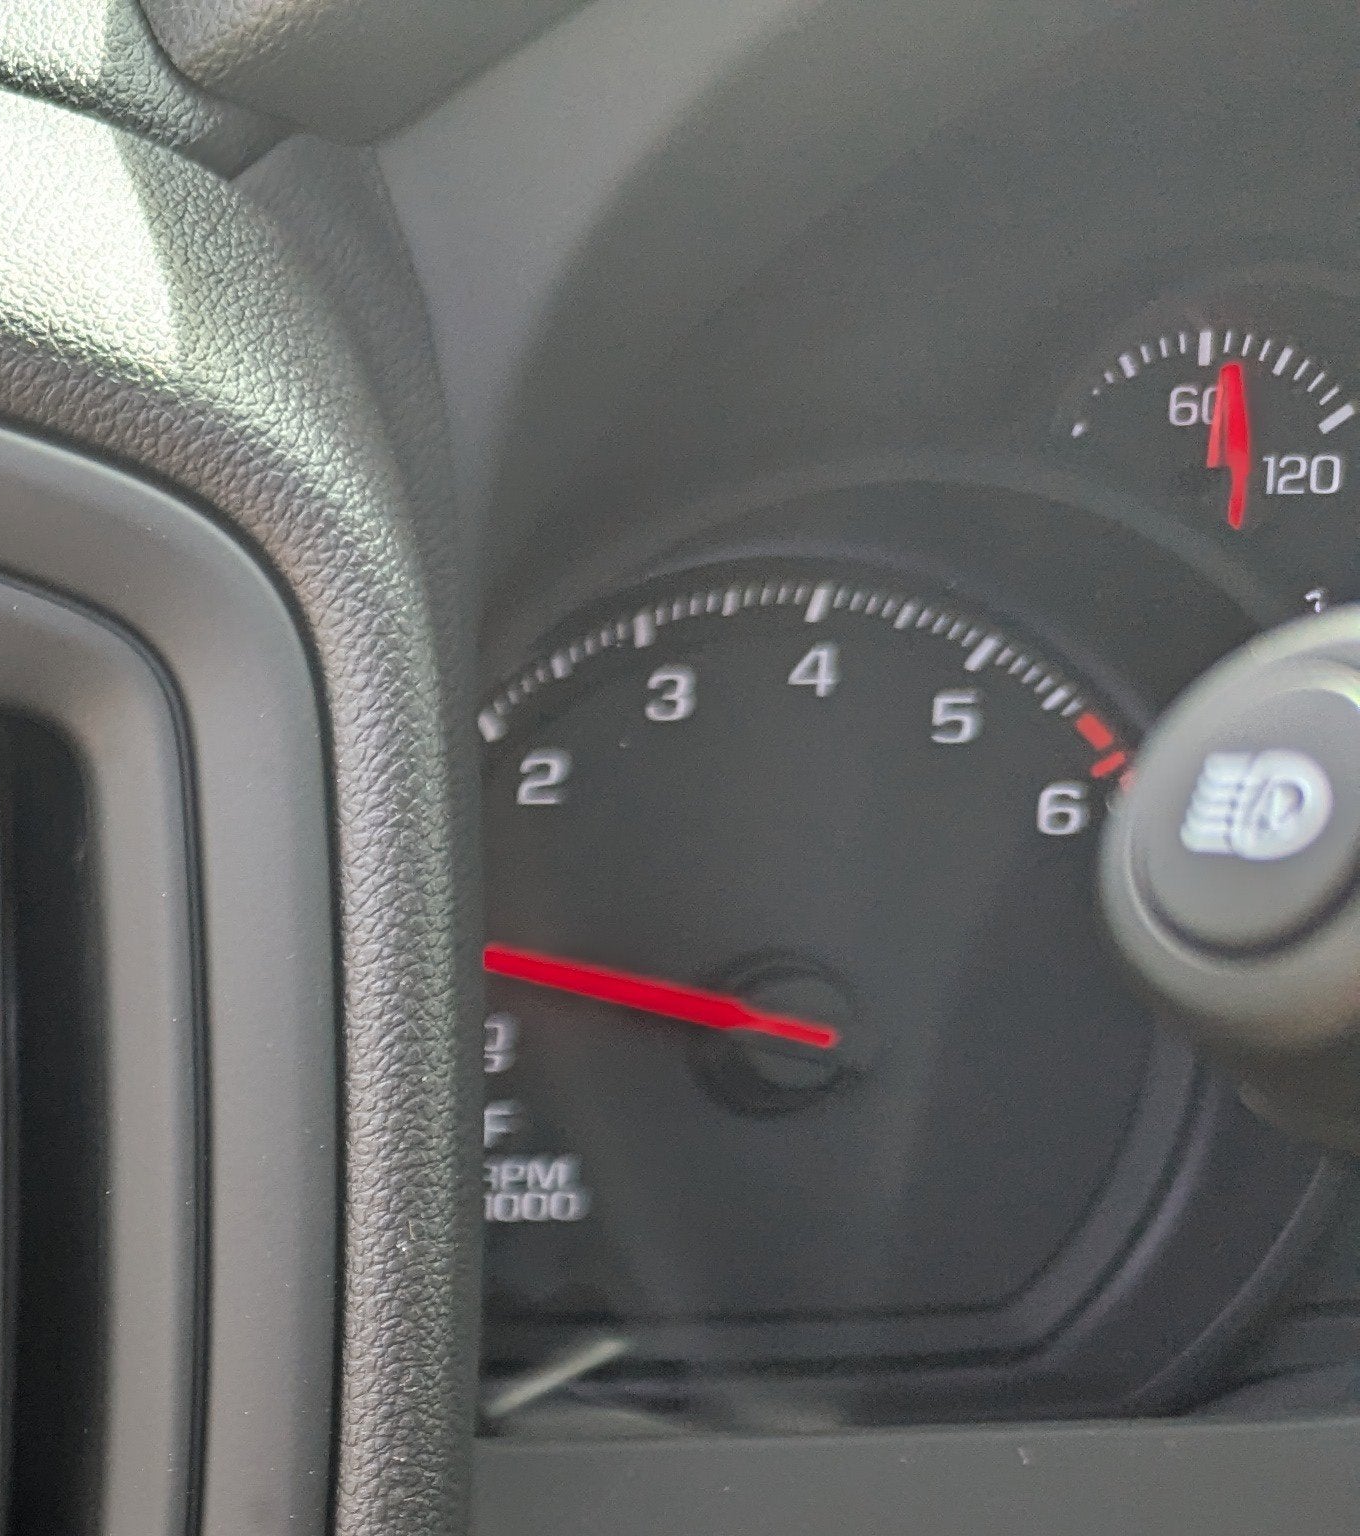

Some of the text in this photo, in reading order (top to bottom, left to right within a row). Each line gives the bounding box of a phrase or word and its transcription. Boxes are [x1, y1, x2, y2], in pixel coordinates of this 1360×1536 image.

[1262, 454, 1341, 495] 120
[645, 666, 696, 722] 3
[787, 643, 839, 698] 4
[931, 688, 981, 744] 5
[517, 751, 570, 804] 2
[1037, 782, 1088, 835] 6
